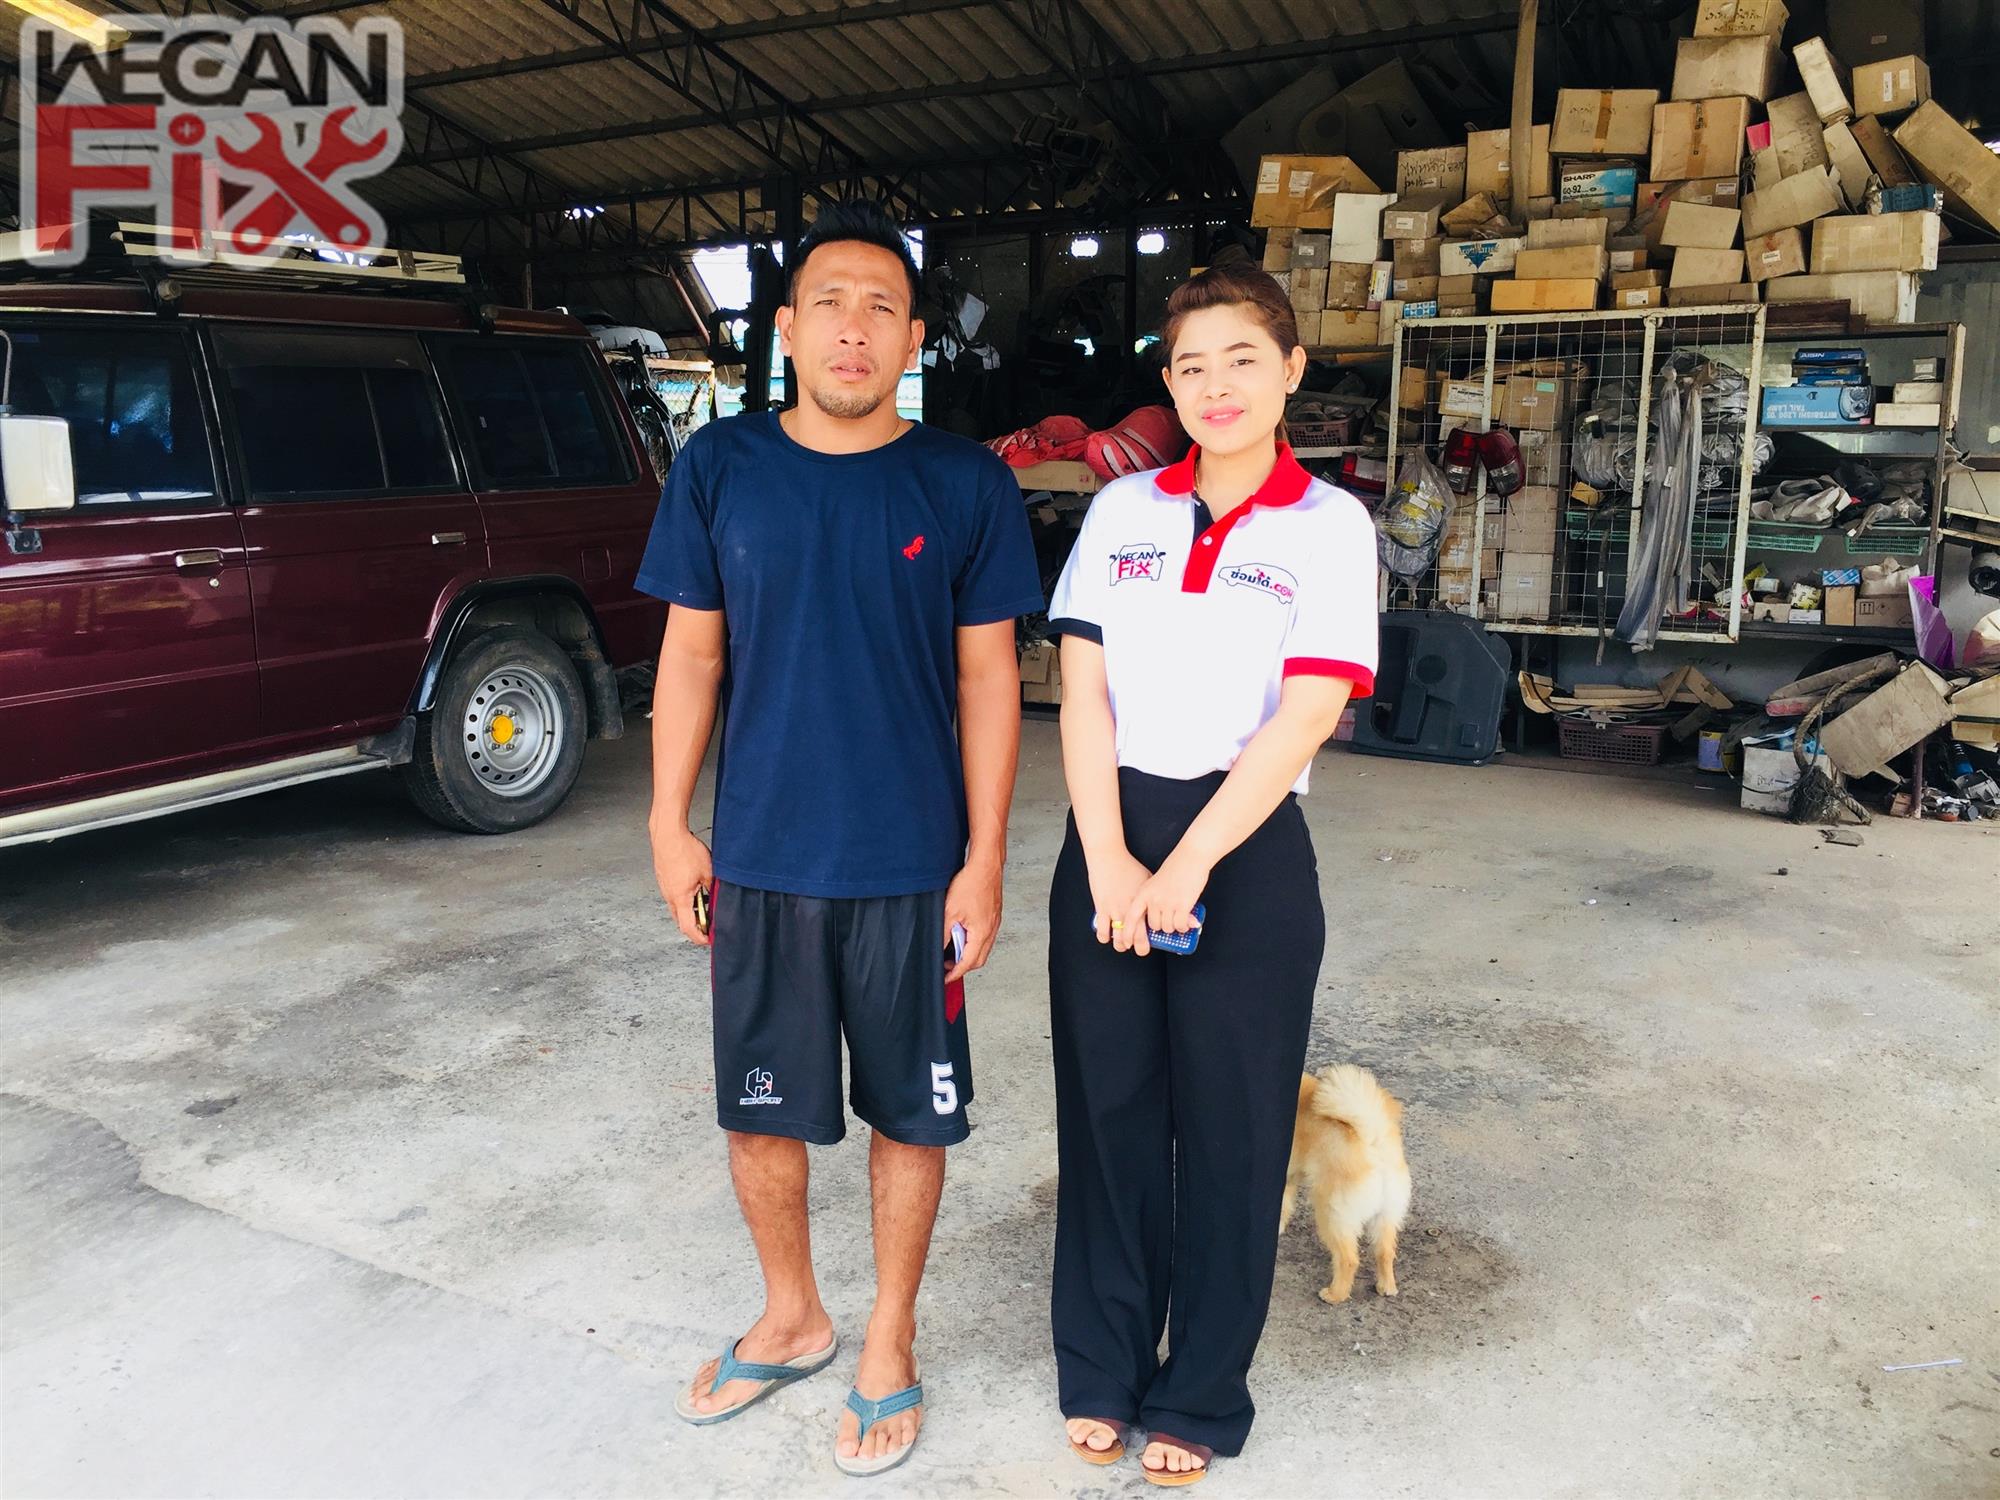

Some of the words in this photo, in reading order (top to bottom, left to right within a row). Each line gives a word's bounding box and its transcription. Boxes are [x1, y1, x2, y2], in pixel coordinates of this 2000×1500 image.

[1563, 173, 1596, 182] SHARP
[1120, 552, 1154, 561] WECAN
[931, 1062, 958, 1115] 5
